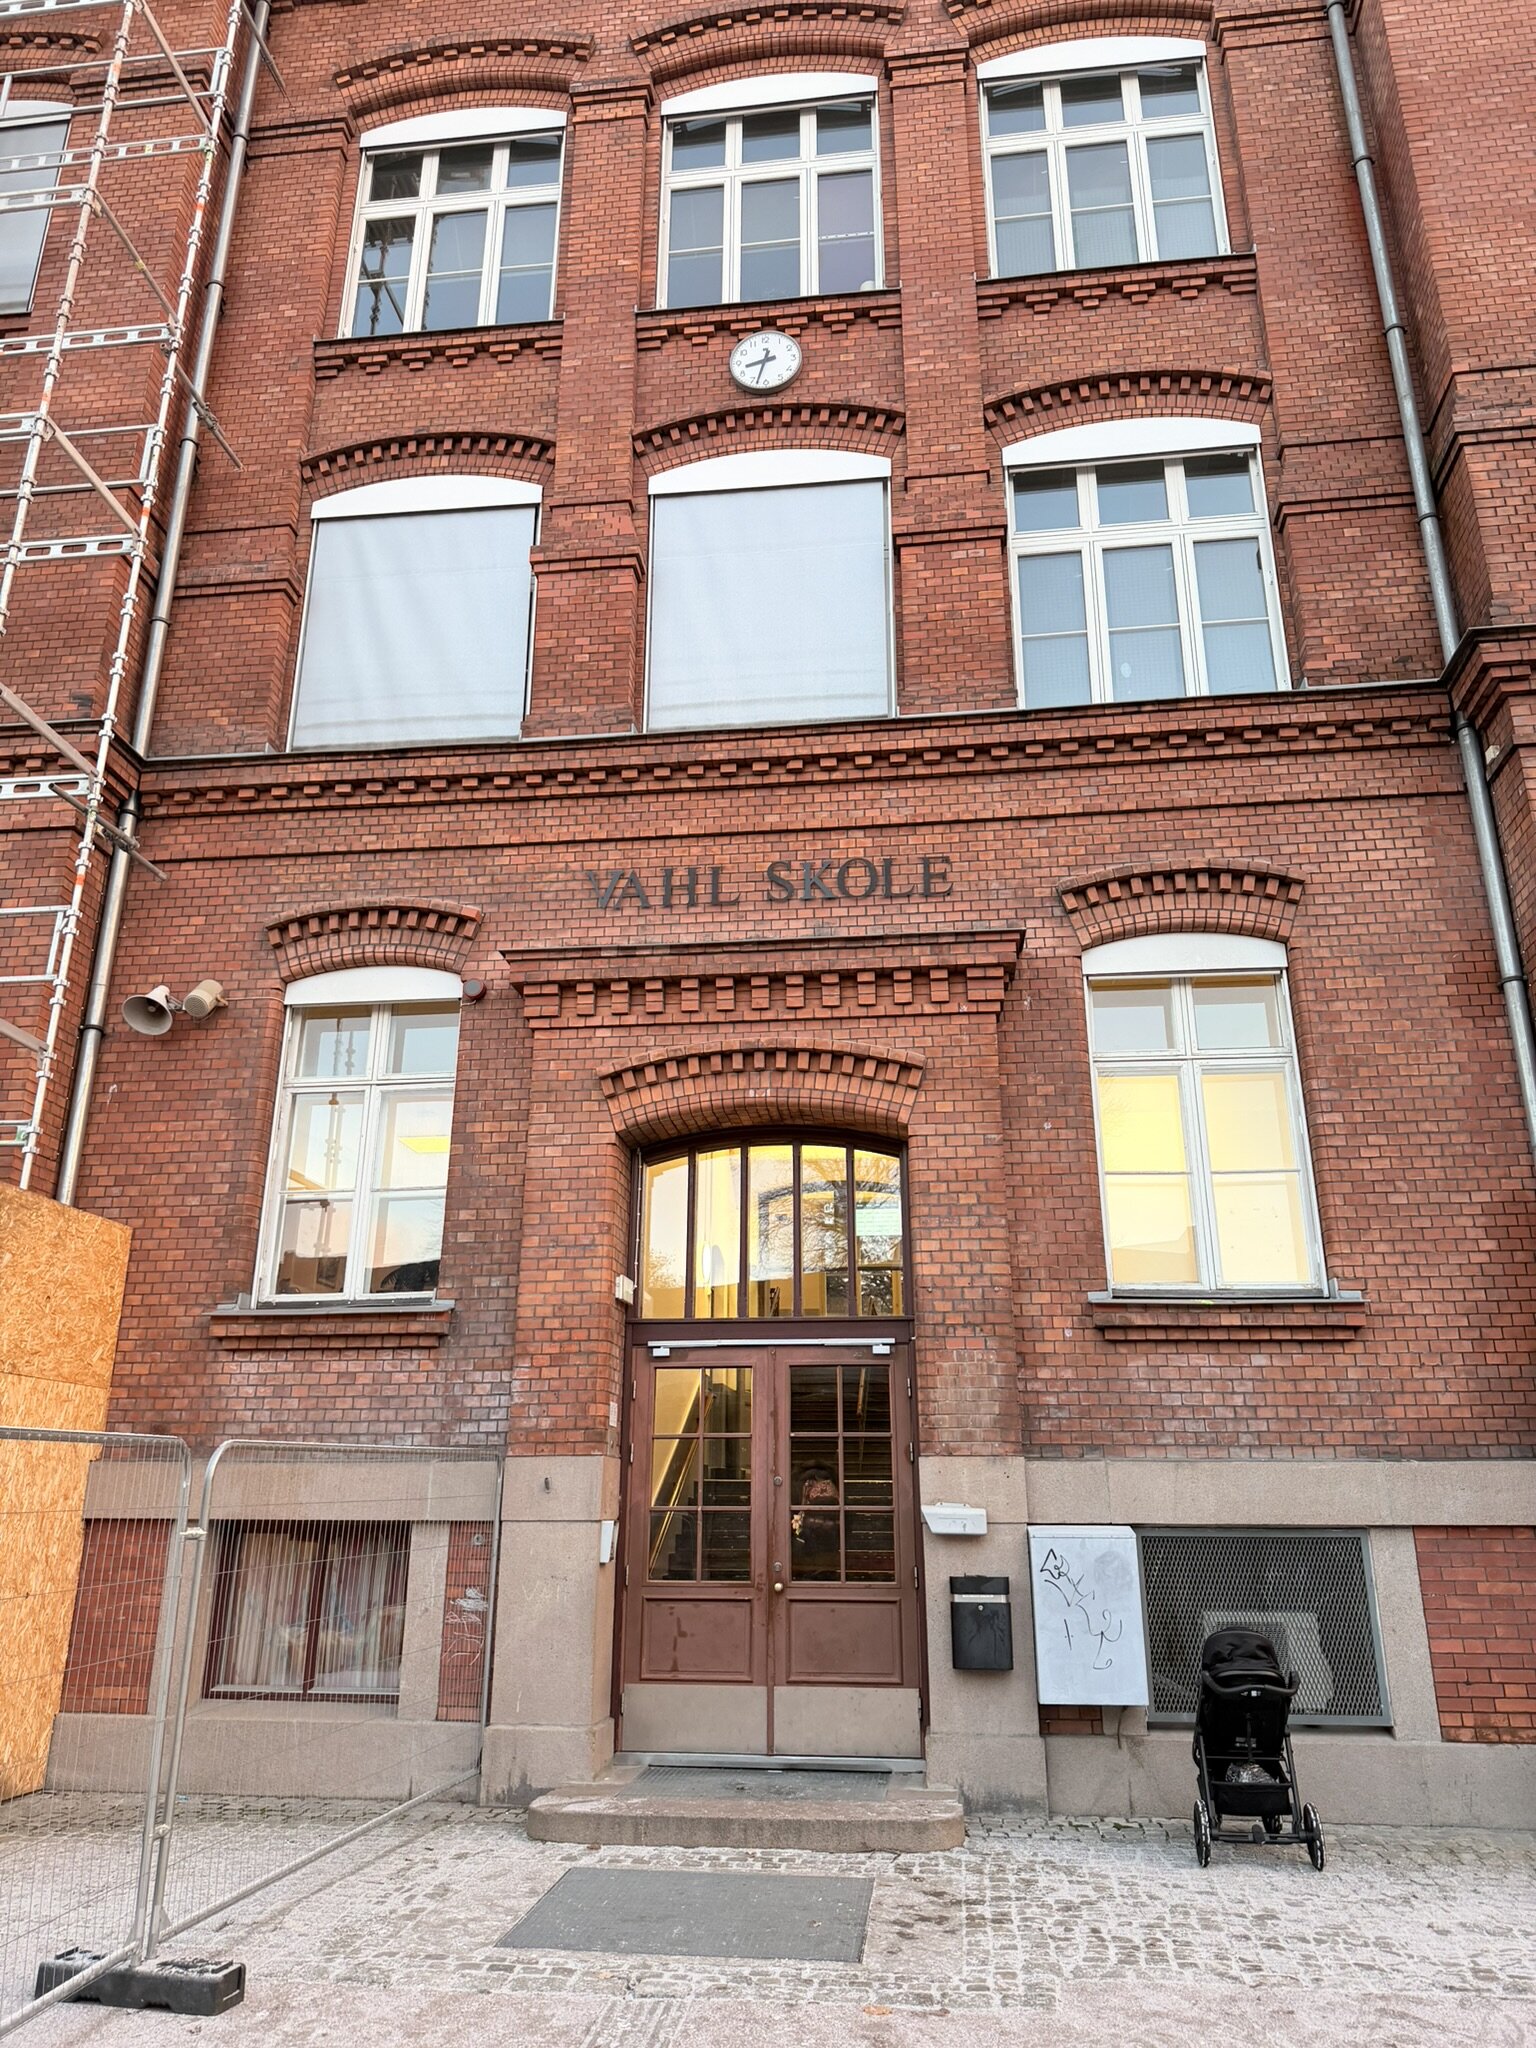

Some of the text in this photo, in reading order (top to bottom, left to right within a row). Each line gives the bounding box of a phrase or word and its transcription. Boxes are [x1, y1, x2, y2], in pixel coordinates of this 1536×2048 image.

[749, 376, 755, 384] 7
[586, 855, 953, 910] VAHL SKOLE
